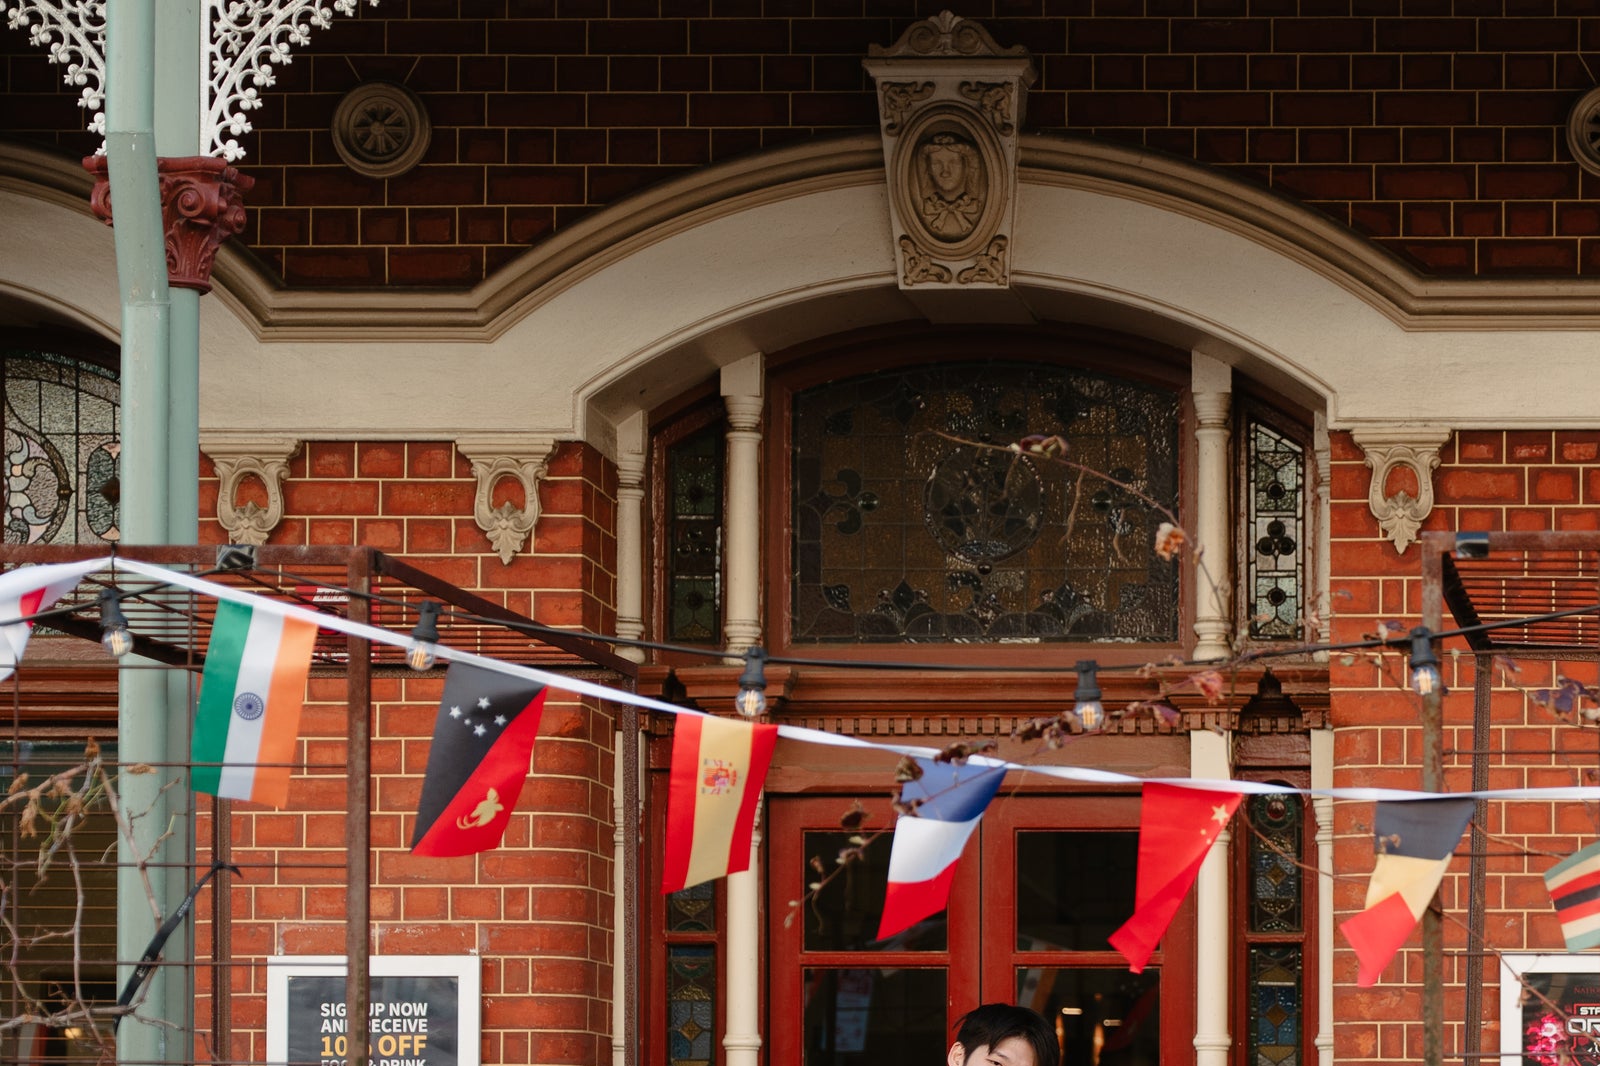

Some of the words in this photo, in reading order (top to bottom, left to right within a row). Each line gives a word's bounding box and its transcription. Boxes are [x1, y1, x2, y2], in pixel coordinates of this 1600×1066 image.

[320, 1002, 347, 1017] SIG
[389, 1002, 428, 1017] NOW
[369, 1018, 428, 1033] ECEIVE
[378, 1035, 428, 1057] OFF
